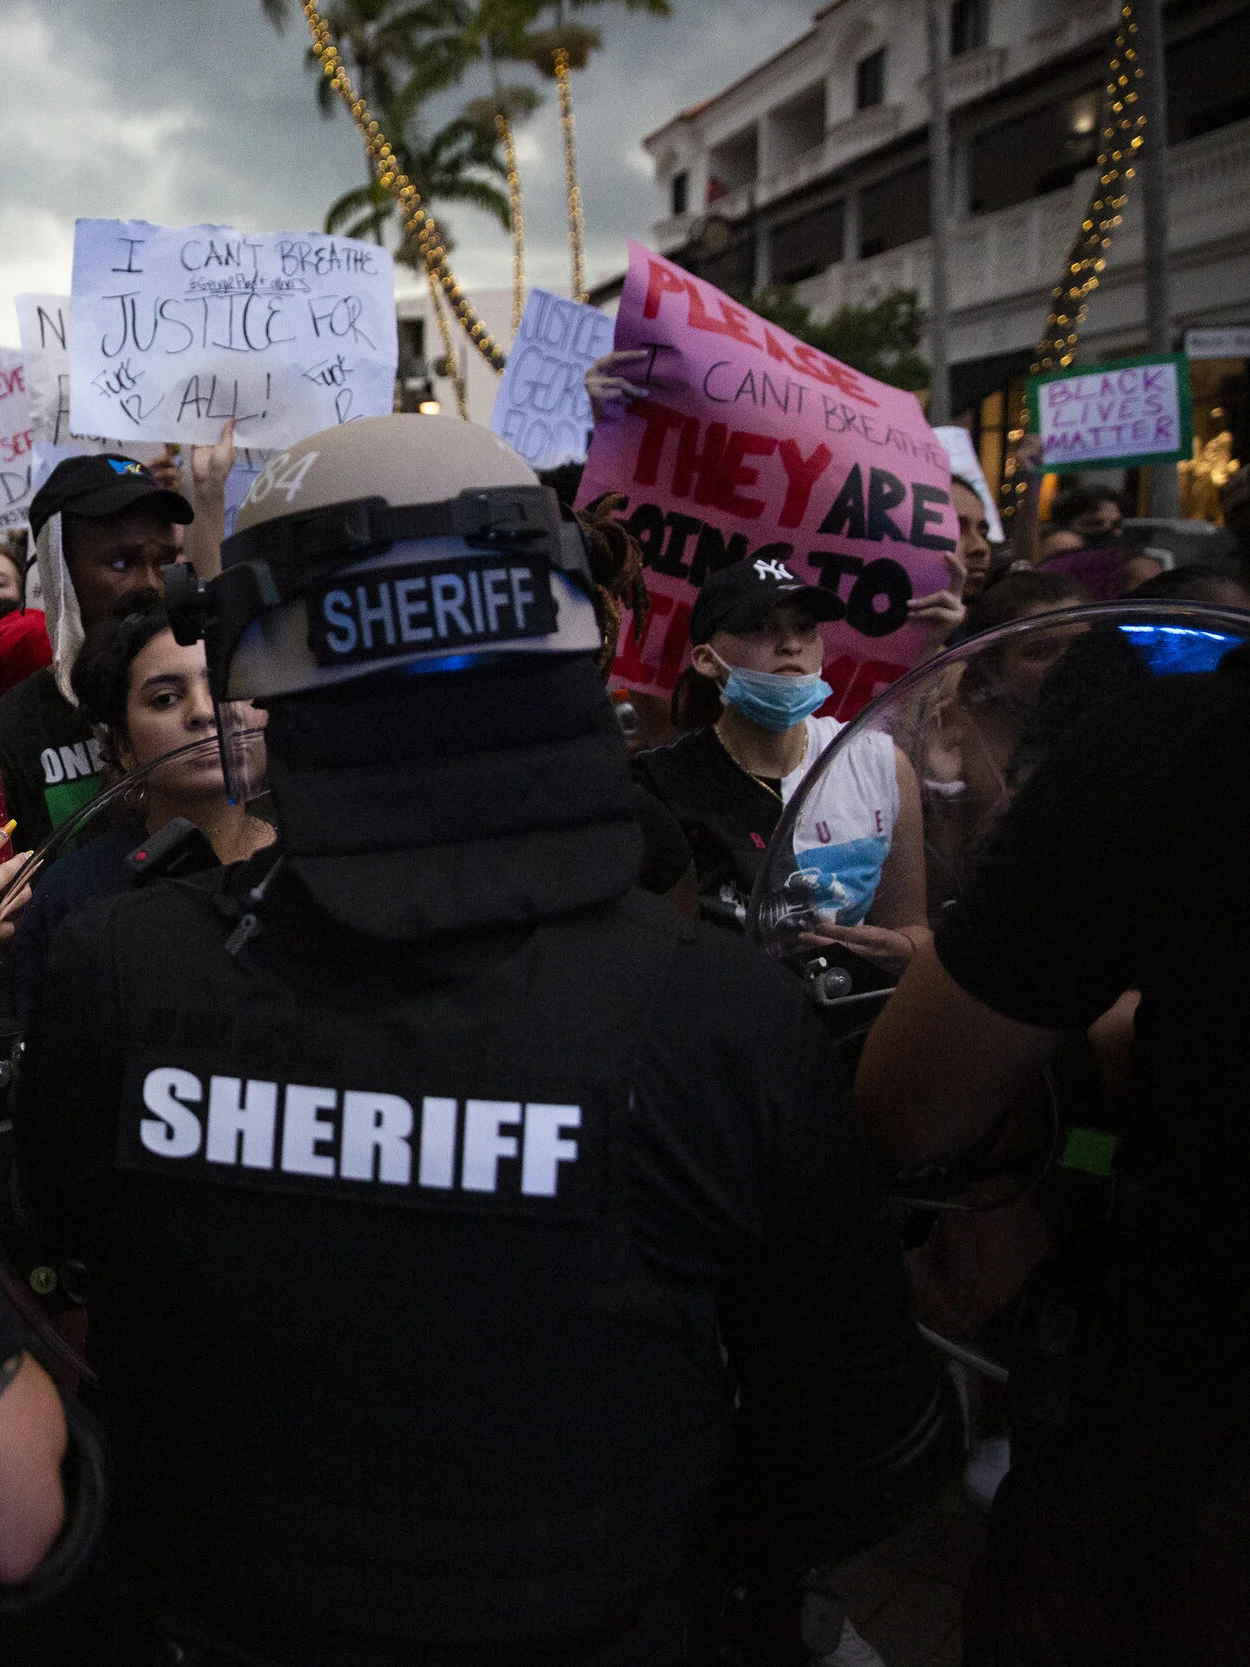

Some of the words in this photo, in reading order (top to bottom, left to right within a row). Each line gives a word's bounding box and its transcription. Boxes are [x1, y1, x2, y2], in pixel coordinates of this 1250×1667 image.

[111, 238, 145, 273] I
[274, 240, 379, 276] BREATHE
[101, 290, 296, 358] JUSTICE
[307, 294, 377, 350] FOR
[644, 258, 878, 408] PLEASE
[177, 372, 271, 423] ALL!
[1048, 366, 1165, 408] BLACK
[1052, 394, 1164, 428] LIVES
[1044, 415, 1174, 452] MATTER
[626, 401, 833, 529] THEY
[817, 462, 958, 552] ARE
[323, 567, 536, 654] SHERIFF
[807, 551, 913, 637] TO
[140, 1067, 582, 1197] SHERIFF
